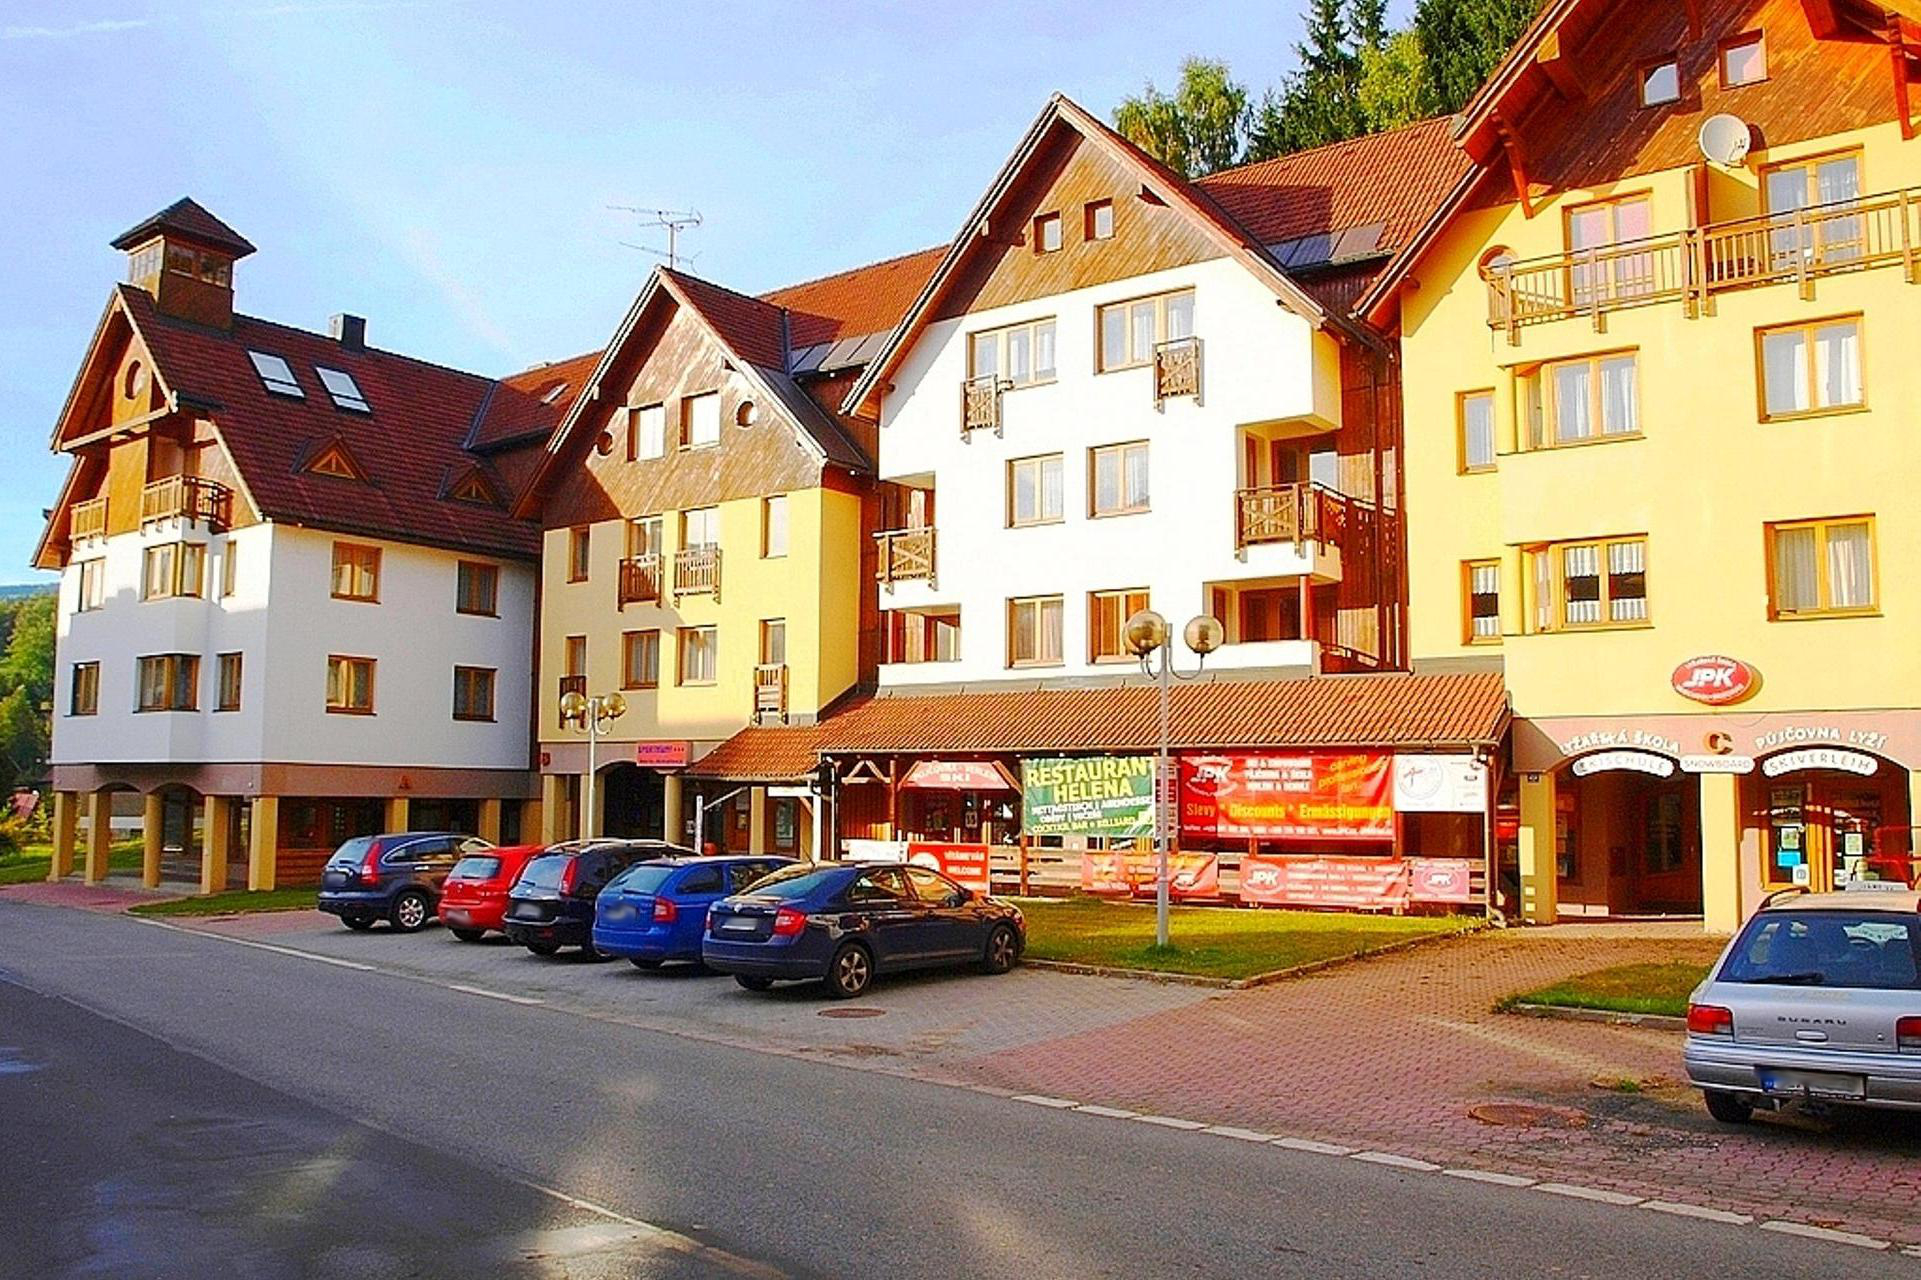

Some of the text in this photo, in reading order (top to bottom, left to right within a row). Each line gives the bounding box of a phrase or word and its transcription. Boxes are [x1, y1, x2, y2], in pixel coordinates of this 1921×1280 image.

[1681, 668, 1737, 688] JPK
[1632, 730, 1680, 753] ŠKOLA
[1755, 726, 1841, 749] PŮJČOVNA
[1684, 758, 1751, 769] SNOWBOARD
[1769, 753, 1871, 772] SKIVERLEIH
[1190, 764, 1232, 784] JPK
[1052, 777, 1134, 803] HELENA
[1186, 803, 1216, 817] Slevy
[1229, 804, 1286, 819] Discounts
[1250, 870, 1279, 886] JPK
[1777, 1016, 1847, 1026] SUBARU
